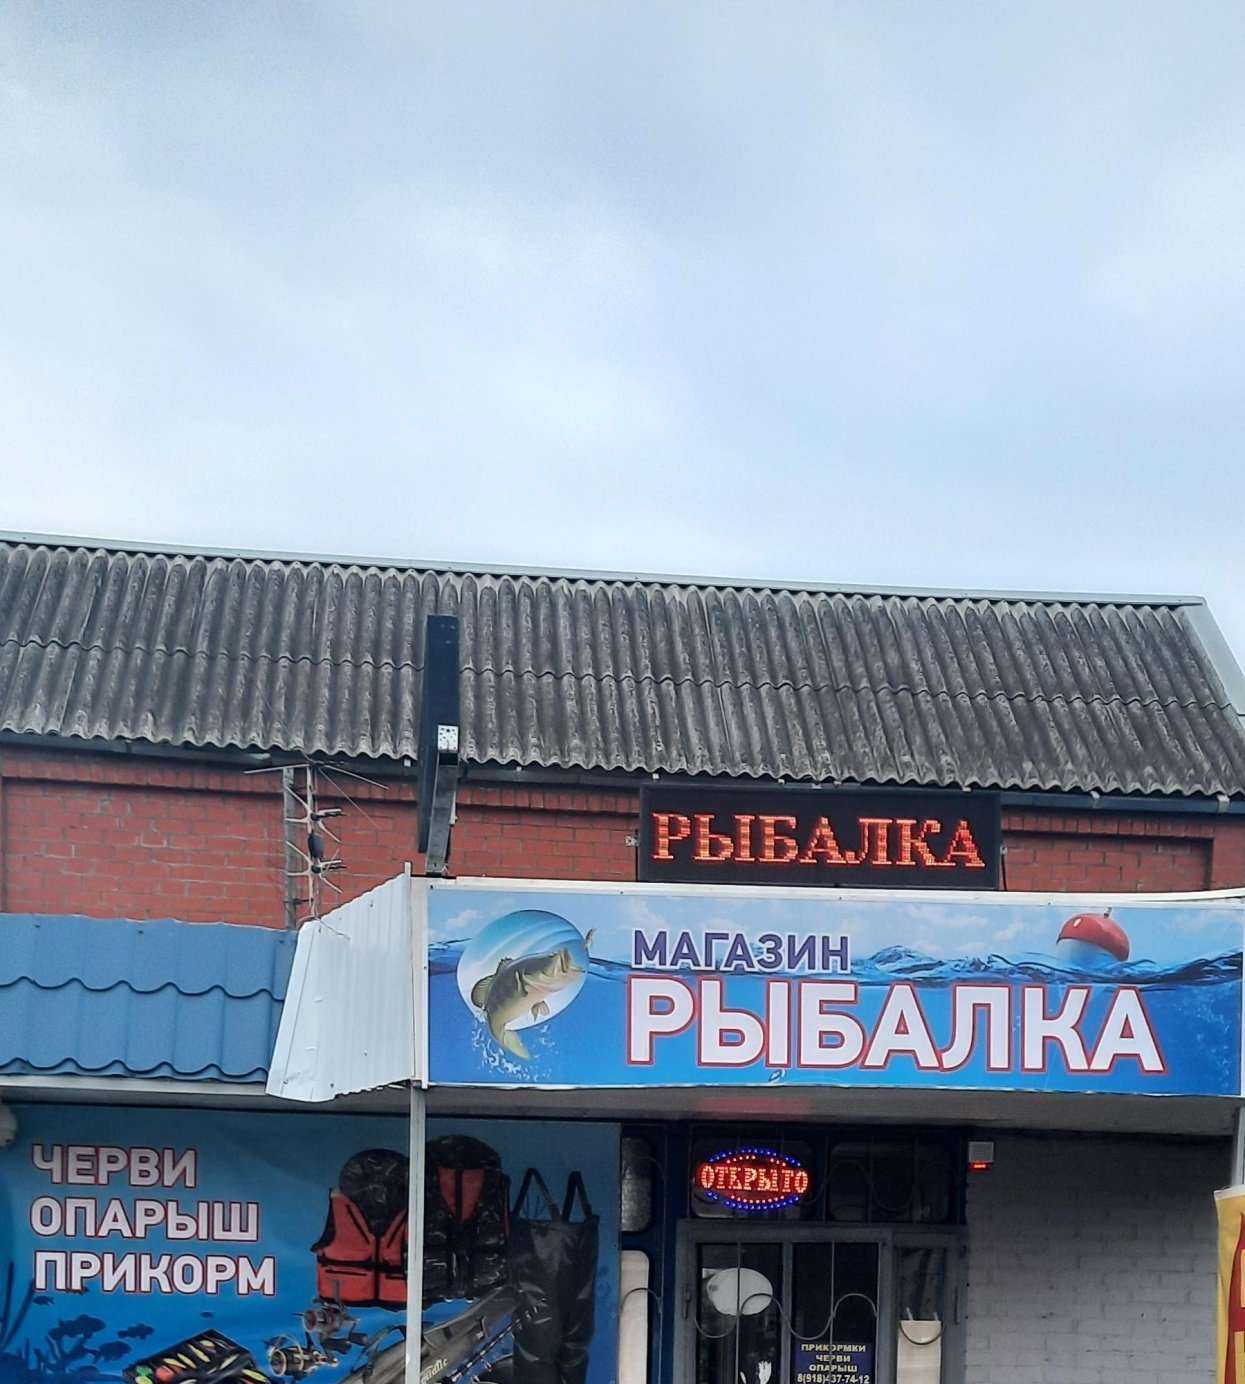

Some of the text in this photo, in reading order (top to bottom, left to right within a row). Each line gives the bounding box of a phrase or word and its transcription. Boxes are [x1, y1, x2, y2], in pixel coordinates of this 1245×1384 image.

[652, 812, 986, 868] РЫБАЛКА
[632, 929, 850, 972] МАГАЗИН
[627, 976, 1167, 1073] РЫБАЛКА
[31, 1143, 198, 1189] ЧЕРВИ
[700, 1165, 809, 1194] ОТКРЫТО
[30, 1197, 260, 1242] ОПАРЫШ
[34, 1250, 277, 1297] ПРИКОРМ
[801, 1344, 866, 1352] ПРИКОРМКИ
[809, 1364, 857, 1372] ОПАРЫШ
